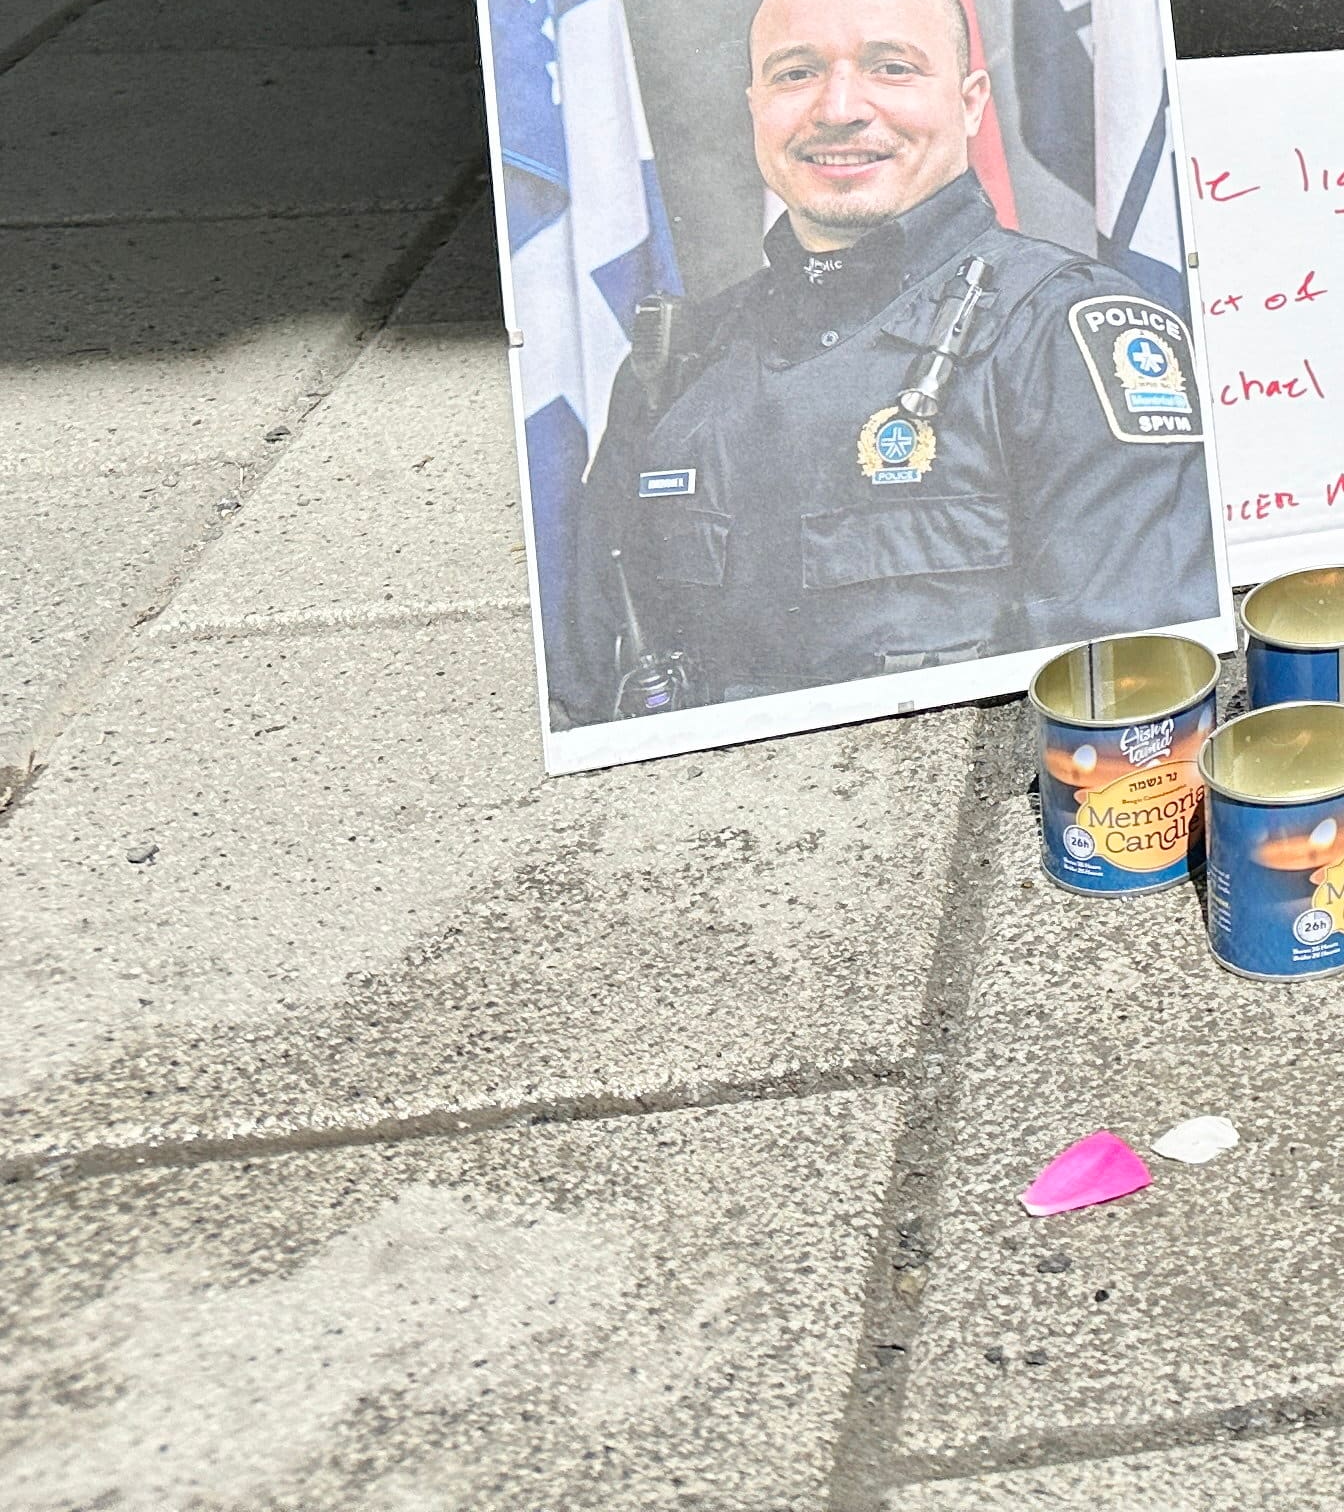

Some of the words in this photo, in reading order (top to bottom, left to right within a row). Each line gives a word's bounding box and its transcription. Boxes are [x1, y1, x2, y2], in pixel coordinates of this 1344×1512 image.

[1202, 294, 1243, 316] ct
[1084, 307, 1182, 341] POLICE
[1214, 358, 1325, 405] chael
[1138, 415, 1192, 432] SPVM
[877, 470, 915, 482] POLICE
[1071, 836, 1090, 849] 26h
[1105, 814, 1200, 854] Candle
[1304, 919, 1327, 933] 26h
